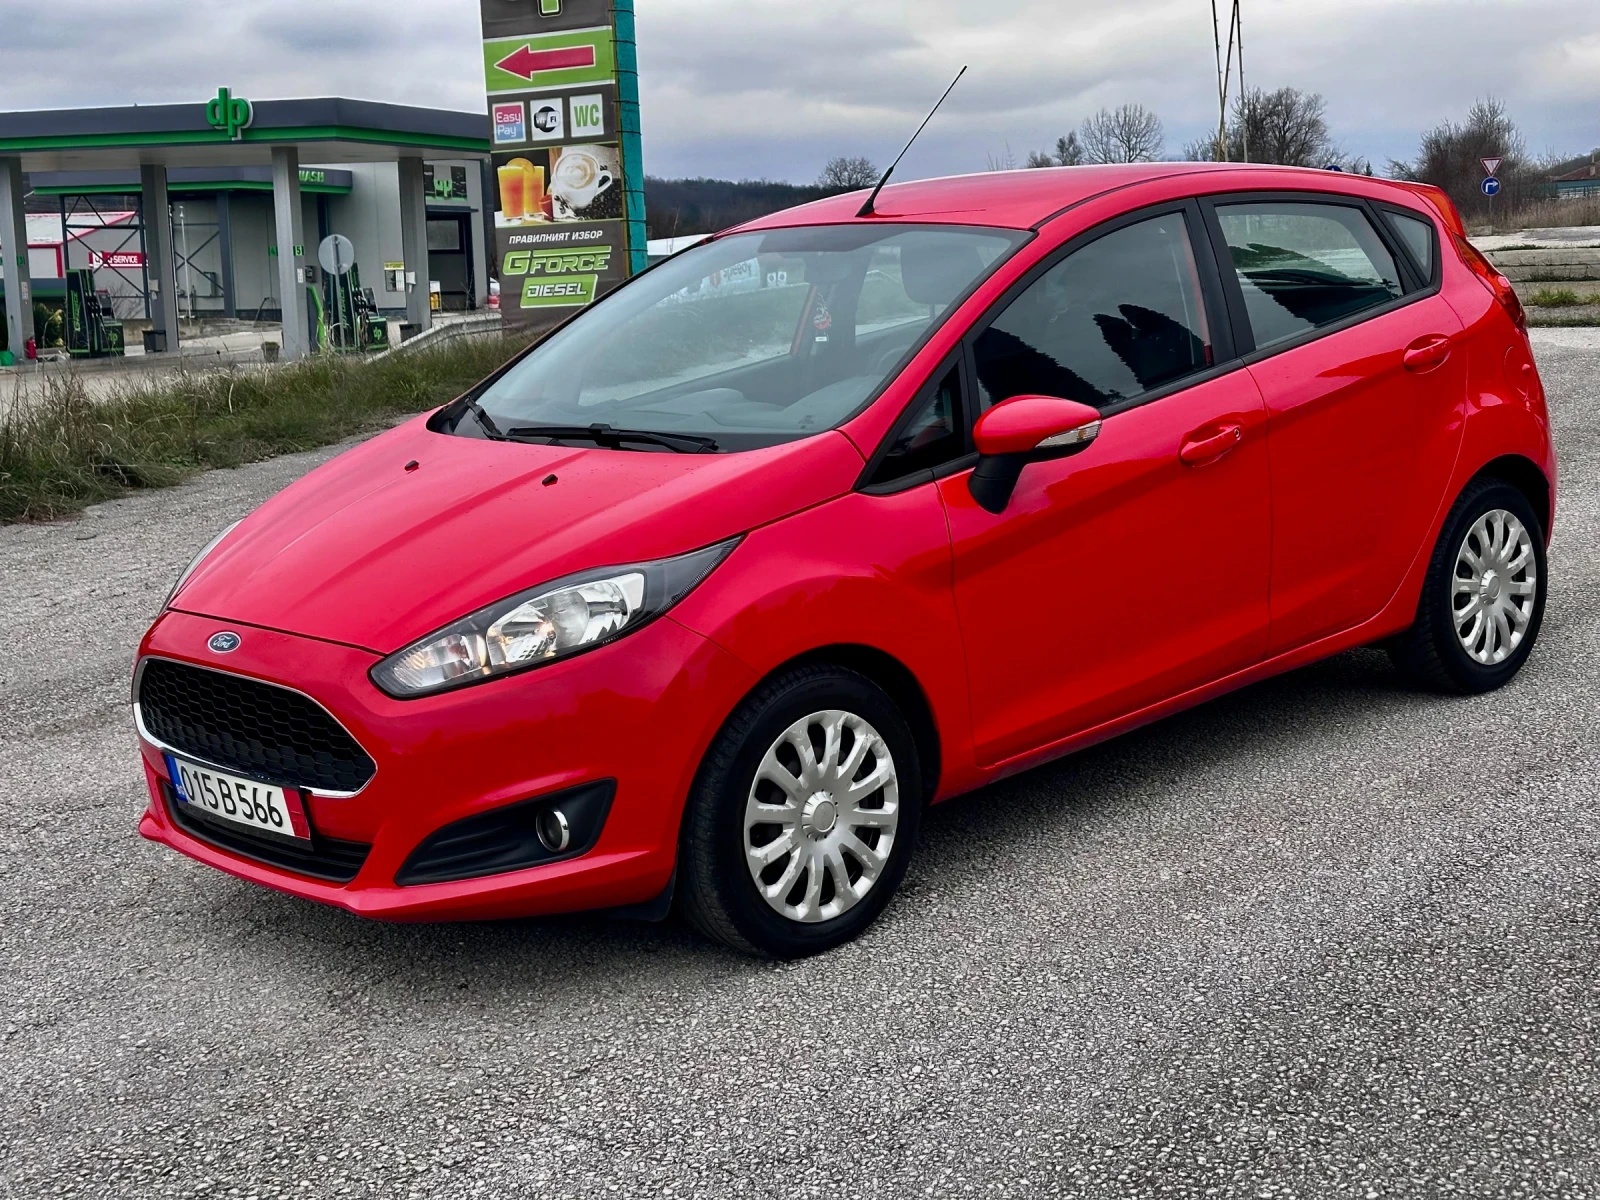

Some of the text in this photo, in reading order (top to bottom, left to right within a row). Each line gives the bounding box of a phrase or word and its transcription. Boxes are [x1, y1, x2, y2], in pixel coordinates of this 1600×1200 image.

[206, 87, 250, 138] dp
[496, 112, 521, 127] Easy
[574, 104, 600, 128] WC
[497, 125, 517, 137] Pay
[298, 170, 324, 182] WASH
[508, 230, 603, 245] ПРАВИЛНИЯТ ИЗБОР
[526, 282, 587, 298] DIESEL
[213, 635, 233, 649] Ford
